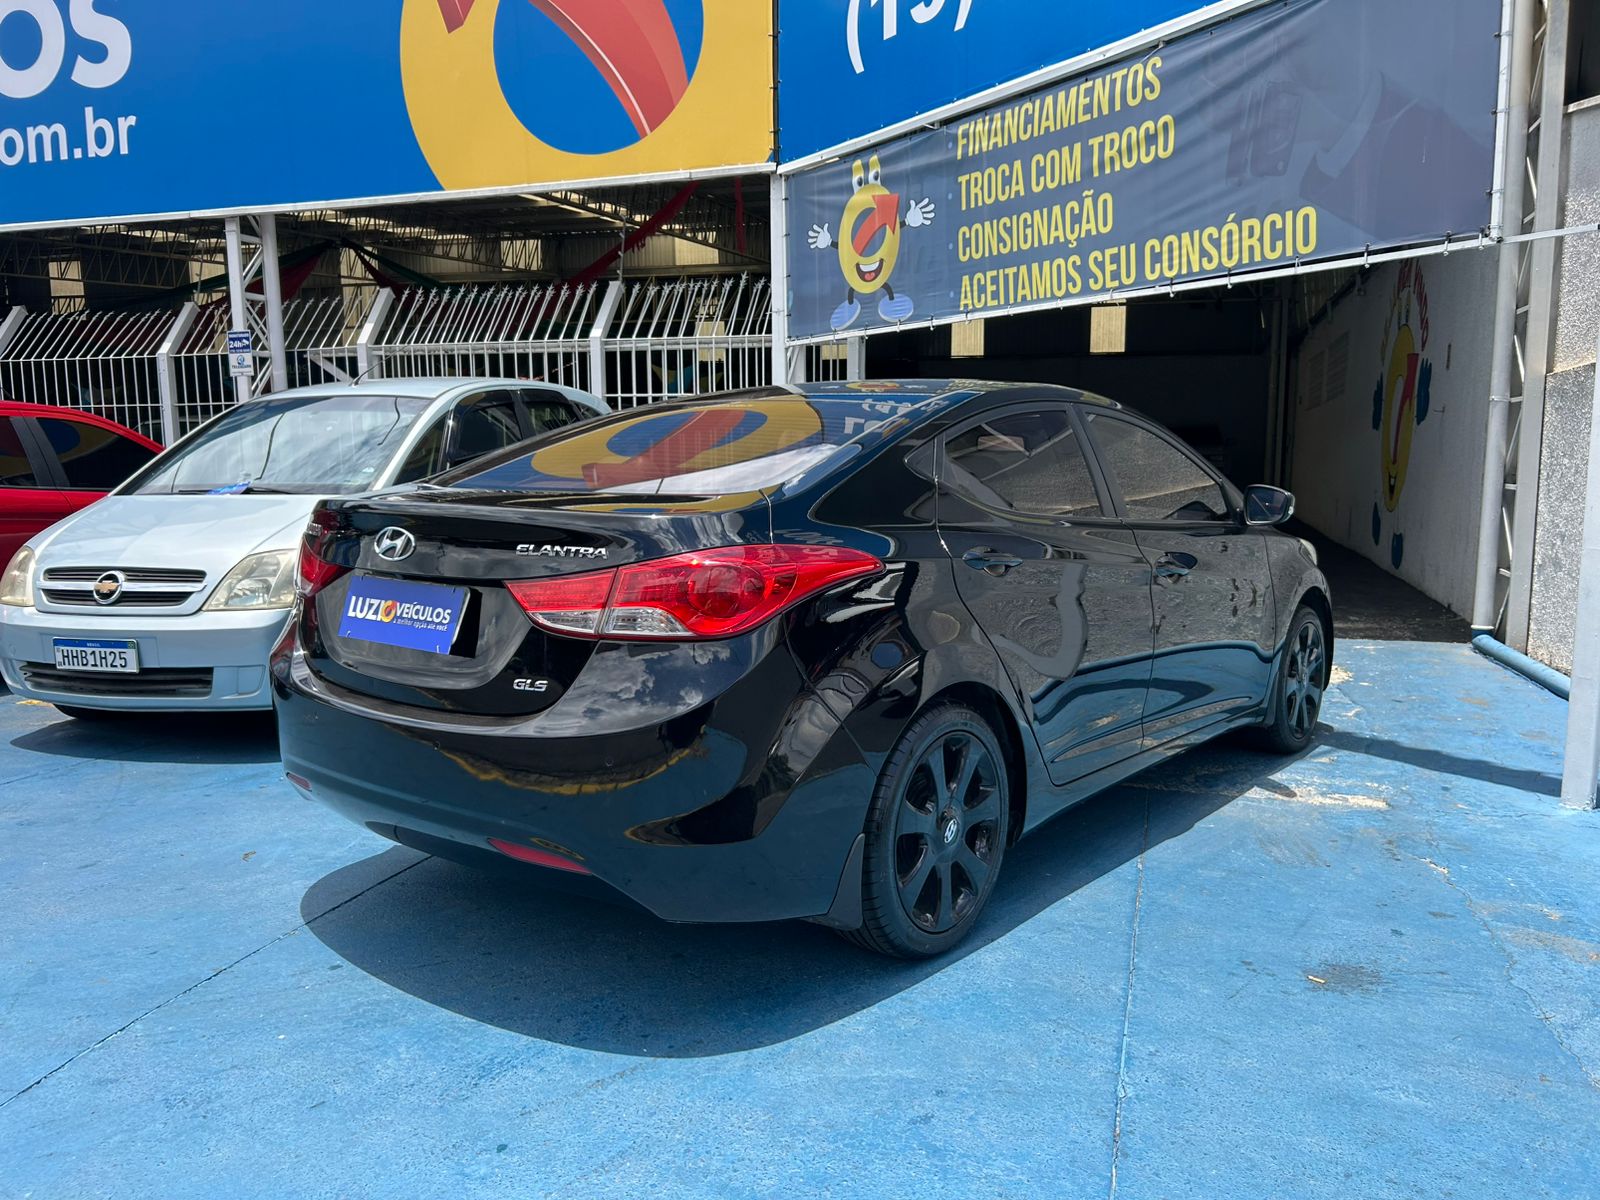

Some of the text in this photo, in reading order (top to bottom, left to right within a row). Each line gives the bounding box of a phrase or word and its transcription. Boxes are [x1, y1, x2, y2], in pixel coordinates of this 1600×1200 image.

[957, 56, 1162, 160] FINANCIAMENTOS
[957, 114, 1175, 211] TROCA COM TROCO
[957, 189, 1113, 262] CONSIGNAÇÃO
[959, 206, 1317, 311] ACEITAMOS SEU CONSÓRCIO
[229, 340, 242, 348] 24h
[516, 544, 609, 559] ELANTRA
[347, 595, 452, 624] LUZIO VEÍCULOS
[61, 649, 127, 668] HHB1H25
[513, 678, 548, 692] GLS
